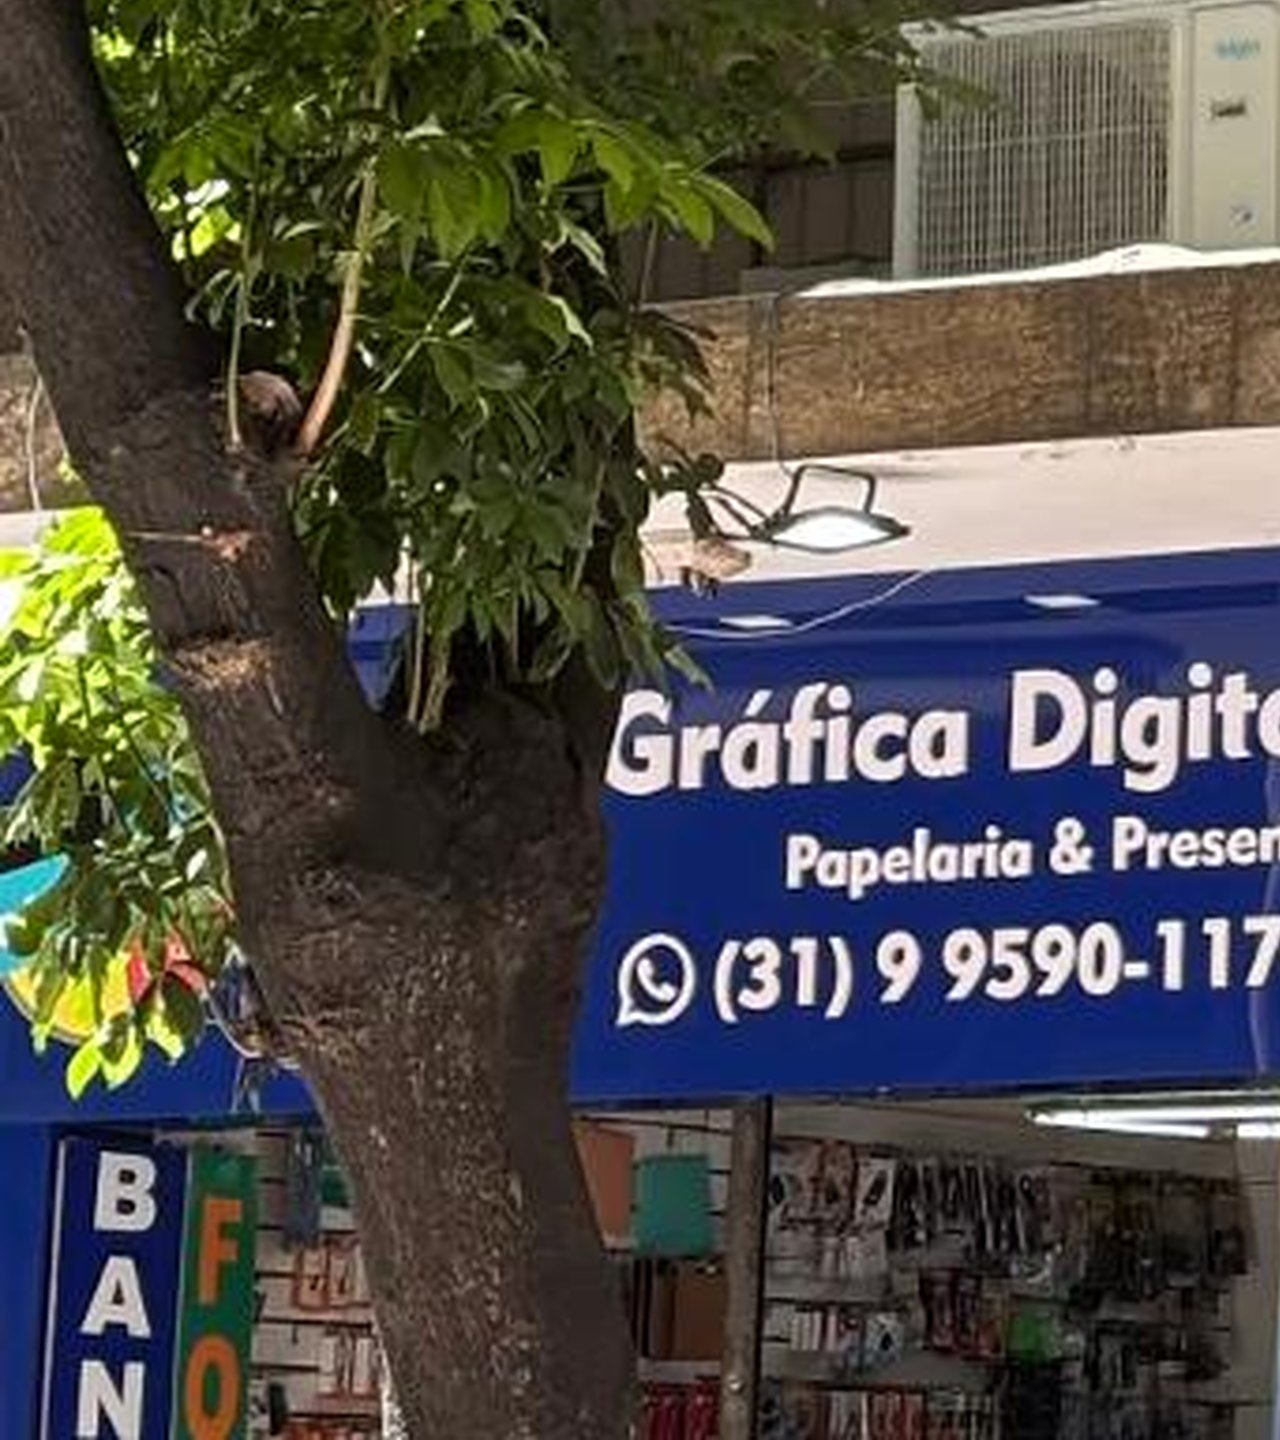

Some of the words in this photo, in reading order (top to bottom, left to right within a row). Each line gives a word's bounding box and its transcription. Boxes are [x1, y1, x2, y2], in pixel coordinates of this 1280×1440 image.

[604, 681, 970, 797] Gráfica
[785, 824, 1034, 900] Papelaria
[1049, 817, 1094, 875] &
[713, 935, 854, 1024] (31)
[875, 930, 922, 1003] 9
[76, 1150, 157, 1440] BAN
